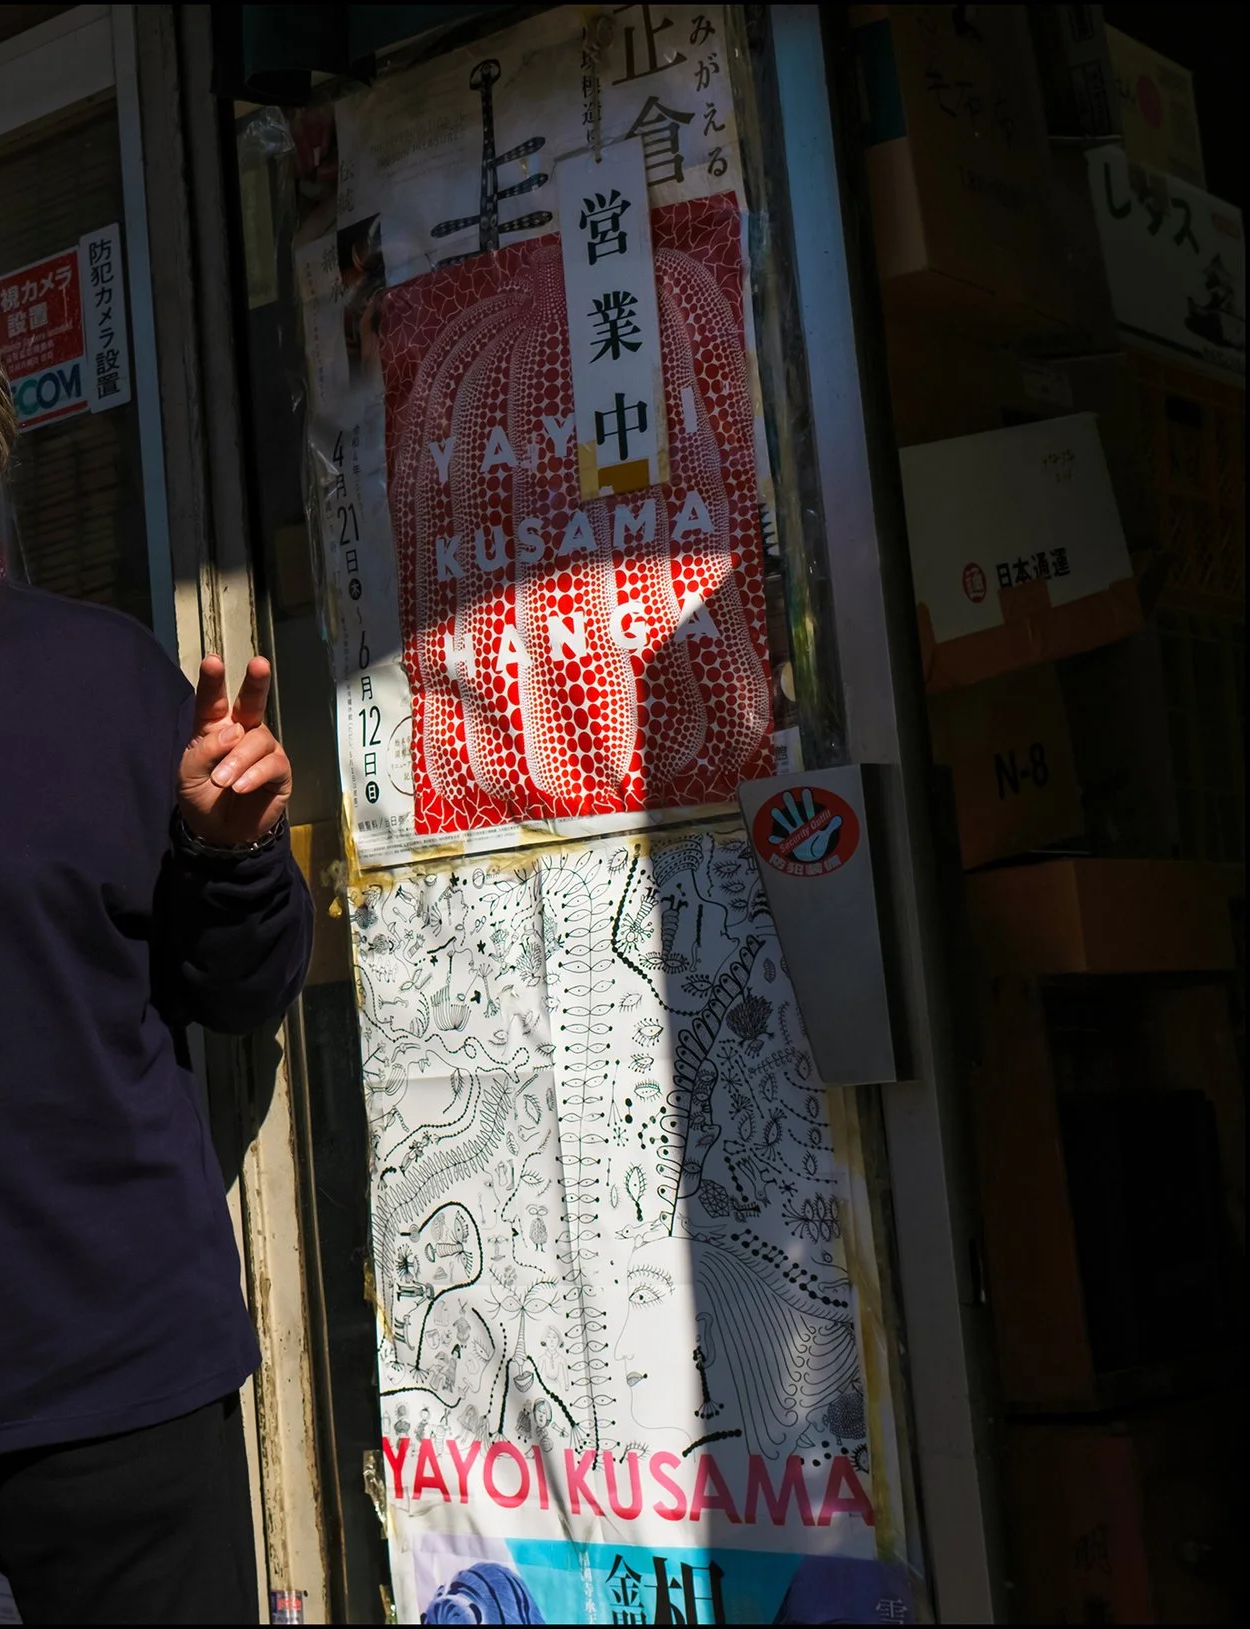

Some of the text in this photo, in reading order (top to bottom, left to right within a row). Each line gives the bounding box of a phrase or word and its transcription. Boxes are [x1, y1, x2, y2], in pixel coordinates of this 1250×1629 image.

[689, 14, 729, 178] みがえる
[7, 302, 49, 338] 設置
[89, 238, 120, 400] 防犯カメラ設置
[579, 189, 647, 460] 営業中
[11, 363, 82, 415] COM
[427, 387, 697, 482] YAYI
[436, 491, 713, 581] KUSAMA
[996, 548, 1071, 588] 日本通運
[444, 592, 719, 677] HANGA
[993, 742, 1049, 799] N-8
[779, 808, 831, 854] Security Outfit
[381, 1436, 876, 1527] YAYOI KUSAMA
